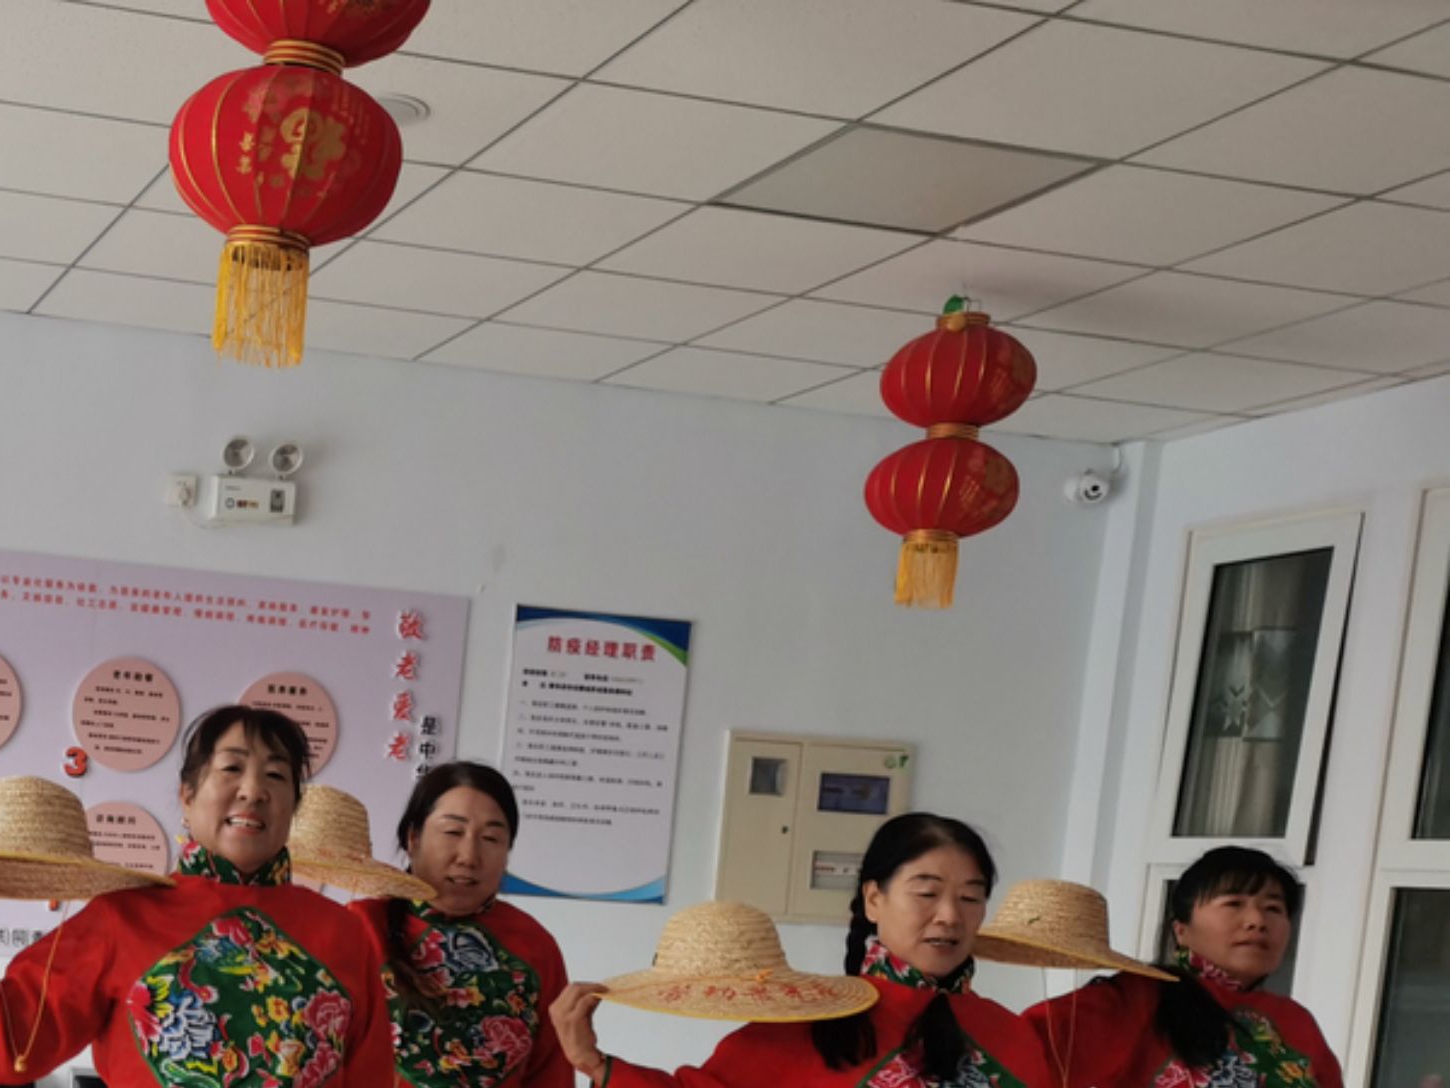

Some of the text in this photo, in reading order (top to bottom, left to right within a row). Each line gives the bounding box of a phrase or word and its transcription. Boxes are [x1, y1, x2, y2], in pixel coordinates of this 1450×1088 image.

[547, 632, 656, 662] 防疫经理职责
[385, 609, 425, 762] 敬老爱老
[63, 747, 88, 778] 3
